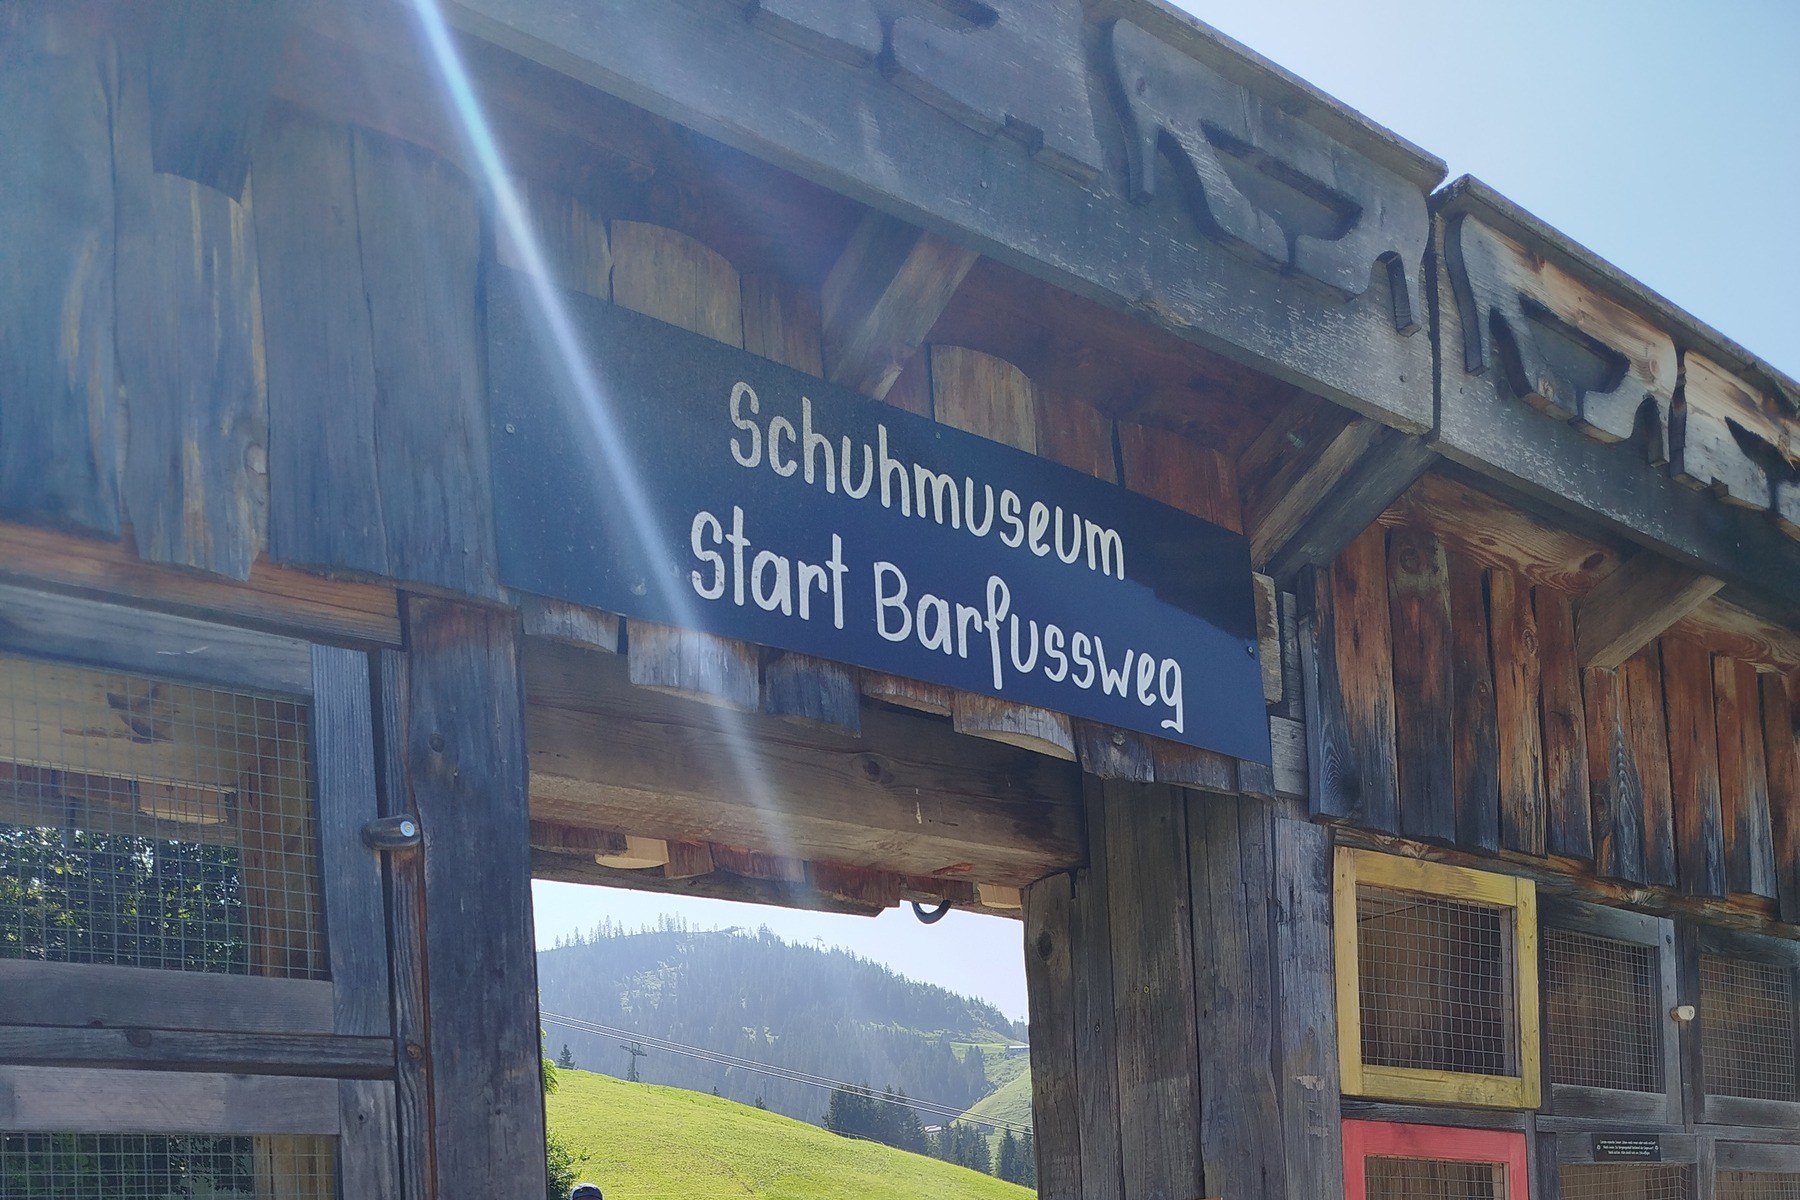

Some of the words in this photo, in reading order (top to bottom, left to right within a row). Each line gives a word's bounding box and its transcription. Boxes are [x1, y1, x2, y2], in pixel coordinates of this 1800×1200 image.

[729, 381, 1125, 580] Schuhmuseum
[690, 505, 849, 630] Start
[874, 560, 1184, 734] Barfussweg
